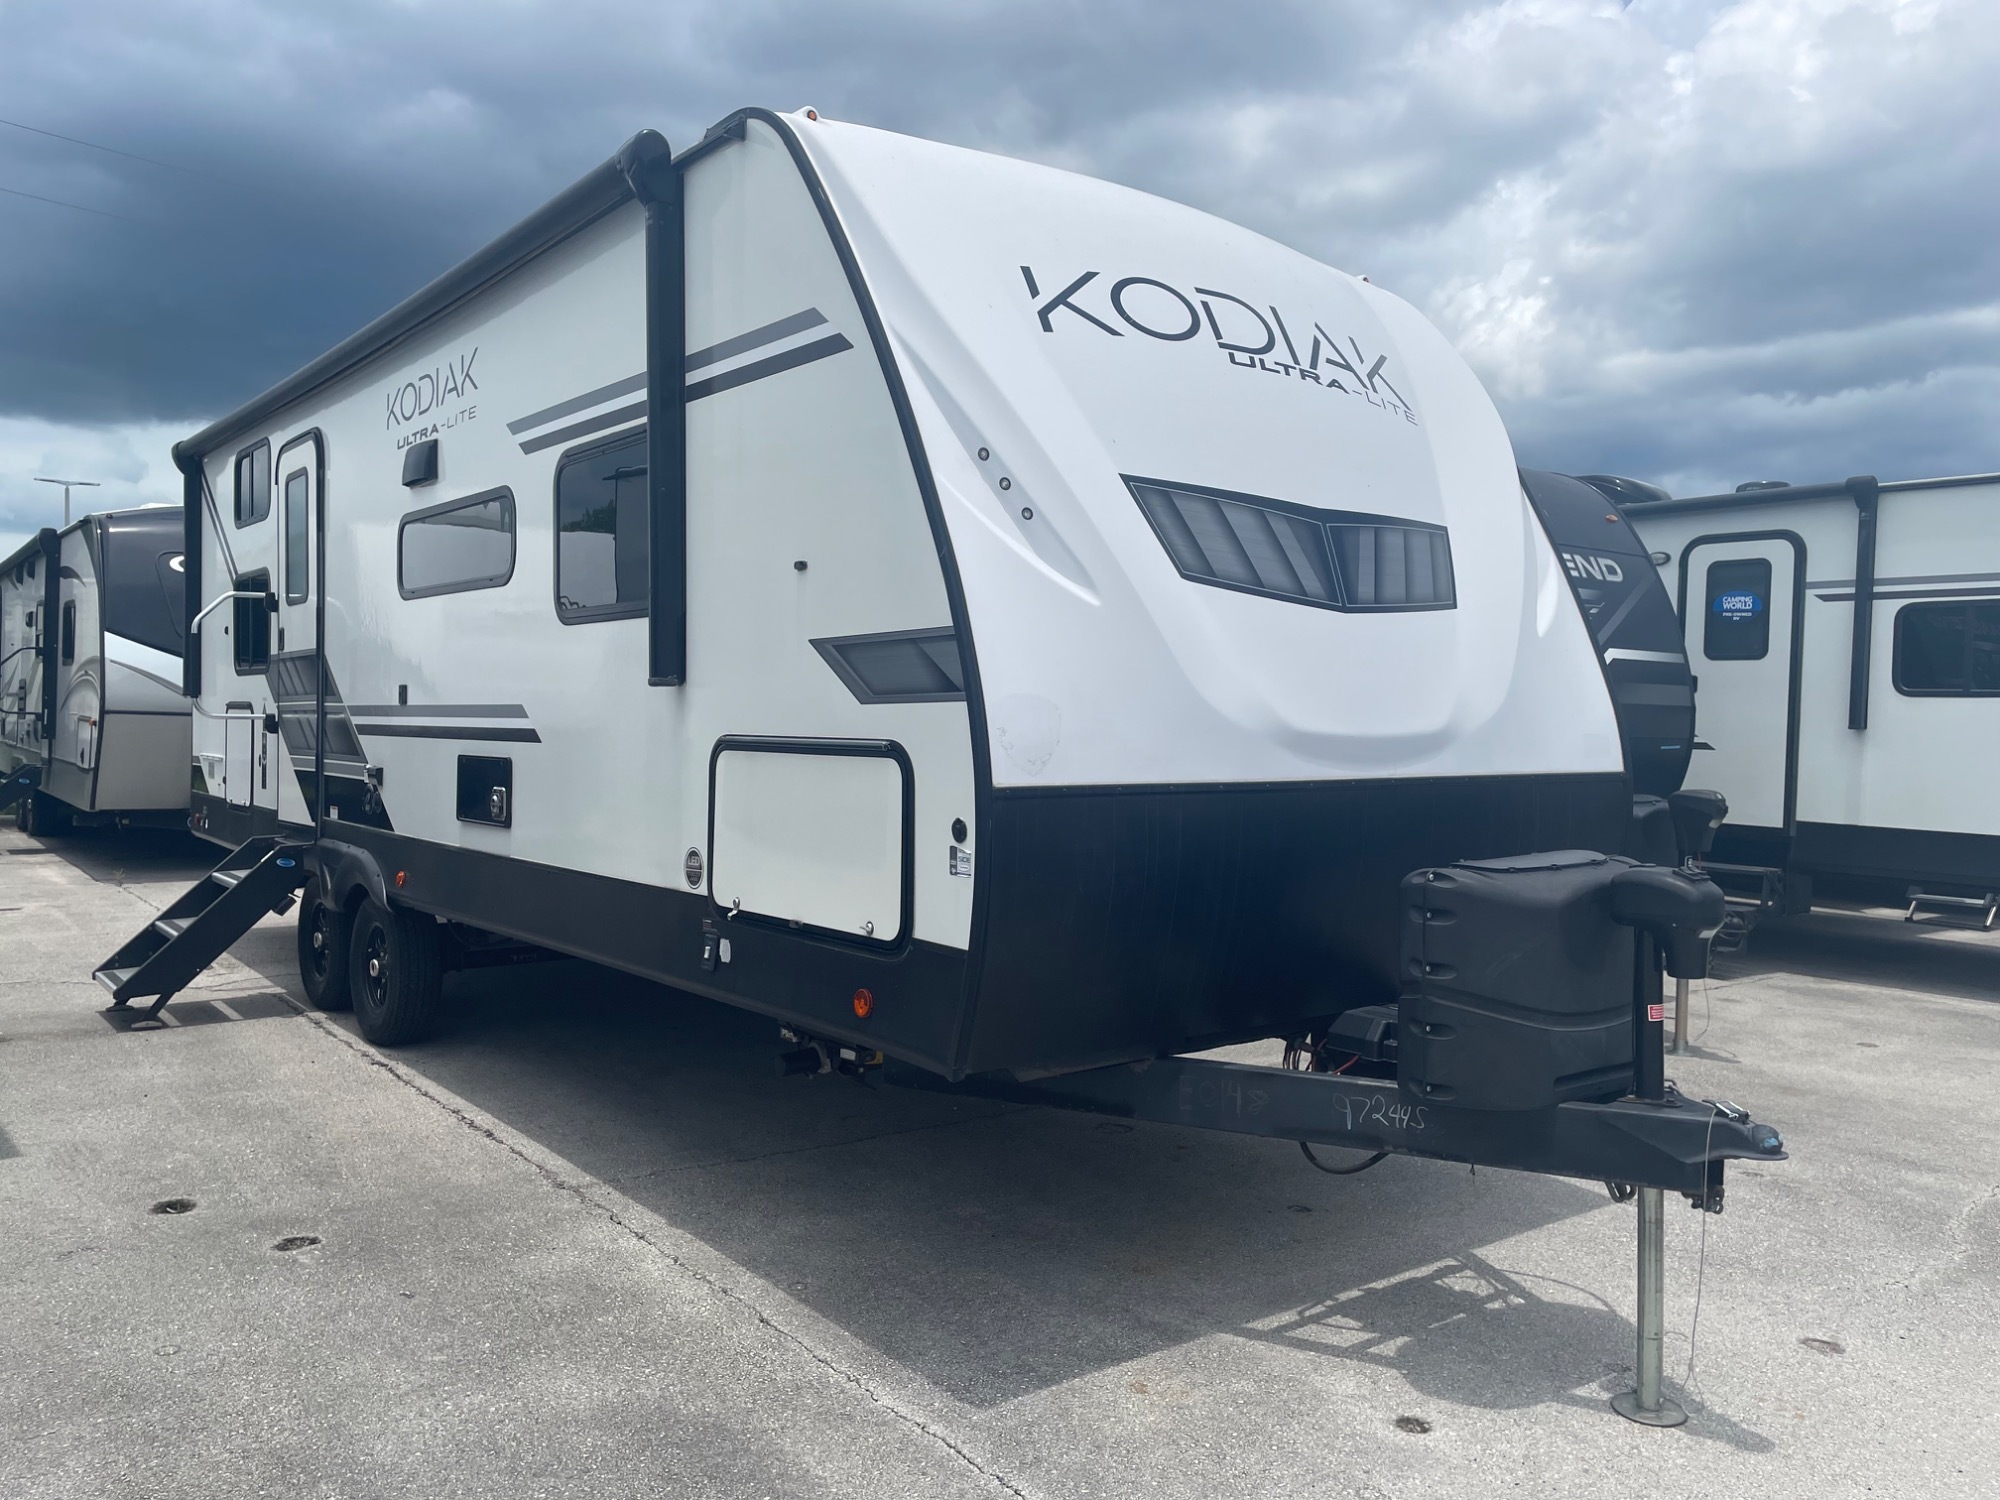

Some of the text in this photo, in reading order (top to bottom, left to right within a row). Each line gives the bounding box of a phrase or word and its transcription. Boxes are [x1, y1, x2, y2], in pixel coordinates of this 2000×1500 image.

[1019, 265, 1413, 413] KODIAK
[386, 346, 479, 431] KODIAK
[1227, 351, 1419, 427] ULTRA-LITE
[396, 405, 478, 450] ULTRA-LITE
[1722, 595, 1753, 603] CAMPING
[1722, 602, 1753, 610] WORLD
